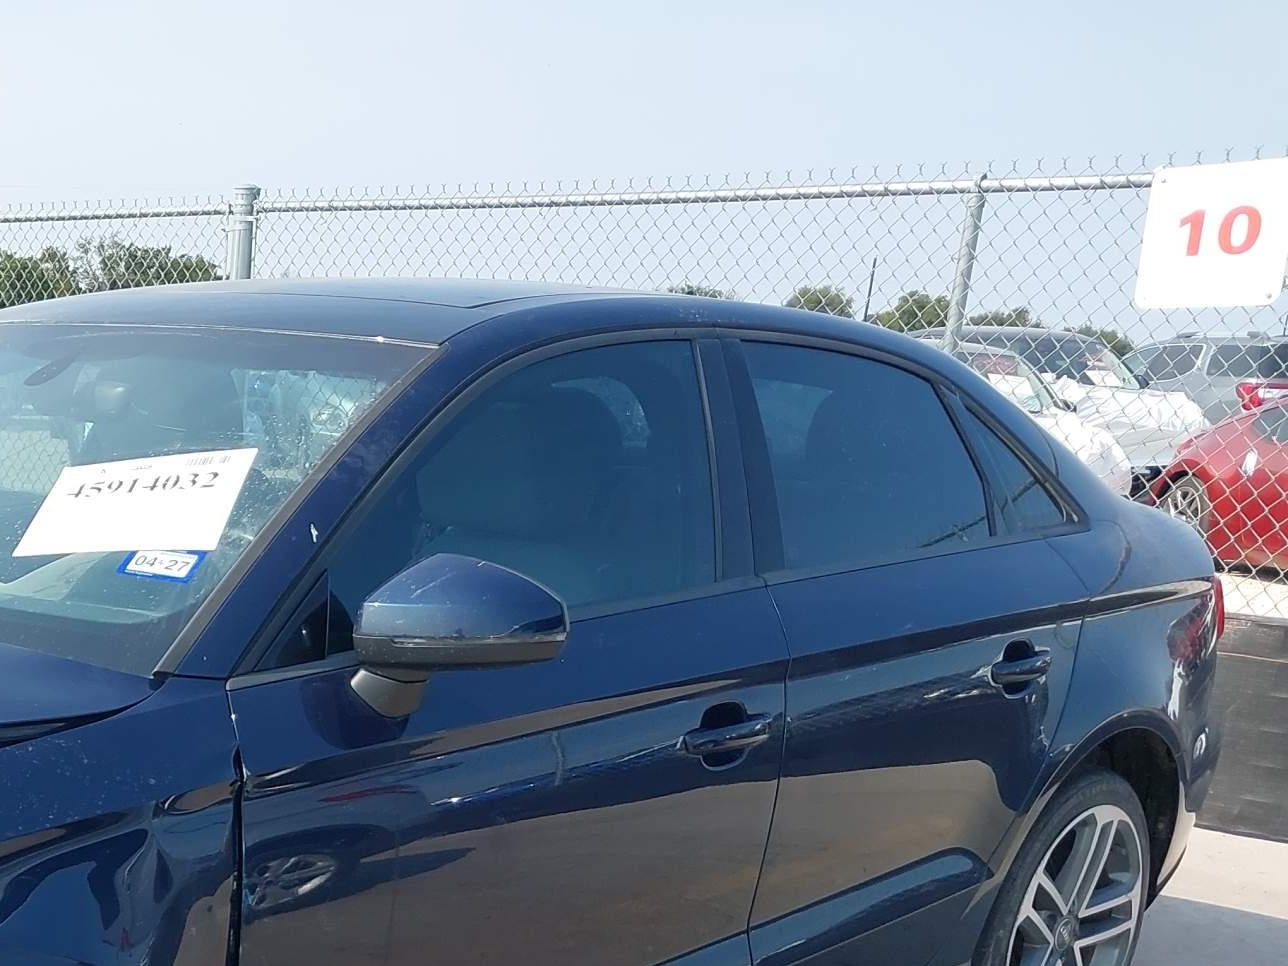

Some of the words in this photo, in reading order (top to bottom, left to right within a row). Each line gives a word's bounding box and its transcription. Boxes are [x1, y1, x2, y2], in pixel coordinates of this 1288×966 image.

[1179, 205, 1262, 257] 10
[67, 472, 219, 499] 45914032
[164, 560, 191, 572] 27
